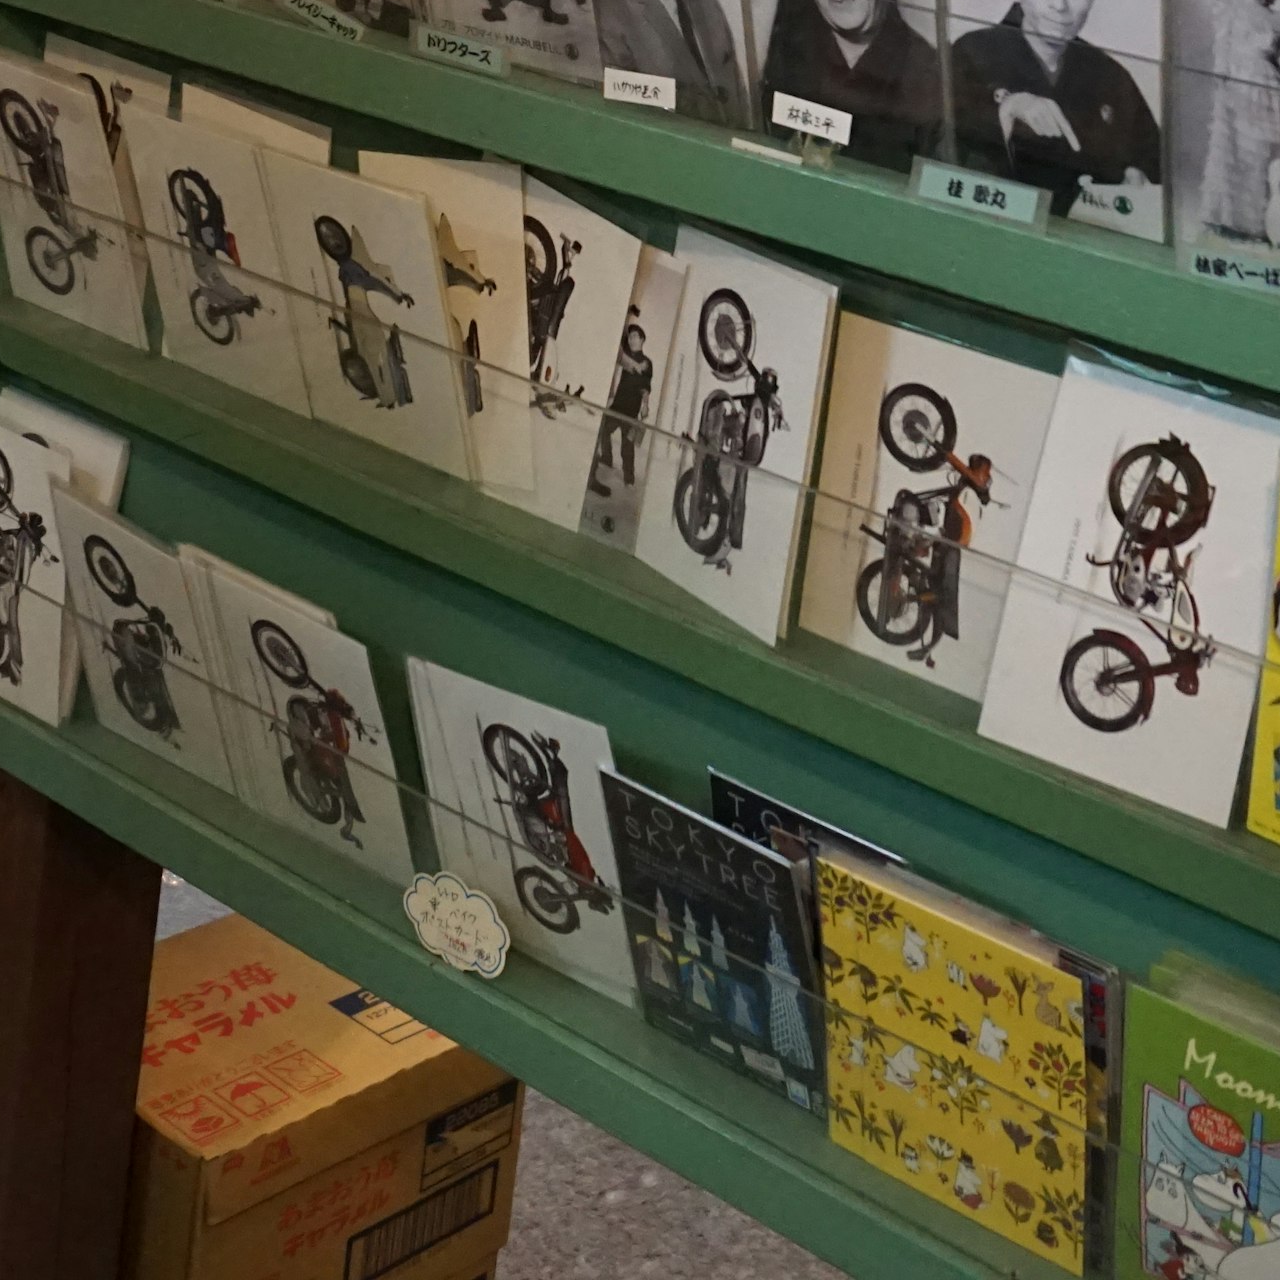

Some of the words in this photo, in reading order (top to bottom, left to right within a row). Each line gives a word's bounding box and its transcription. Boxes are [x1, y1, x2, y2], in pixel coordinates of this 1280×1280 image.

[618, 786, 777, 884] TOKYO
[140, 990, 298, 1068] キャラメル
